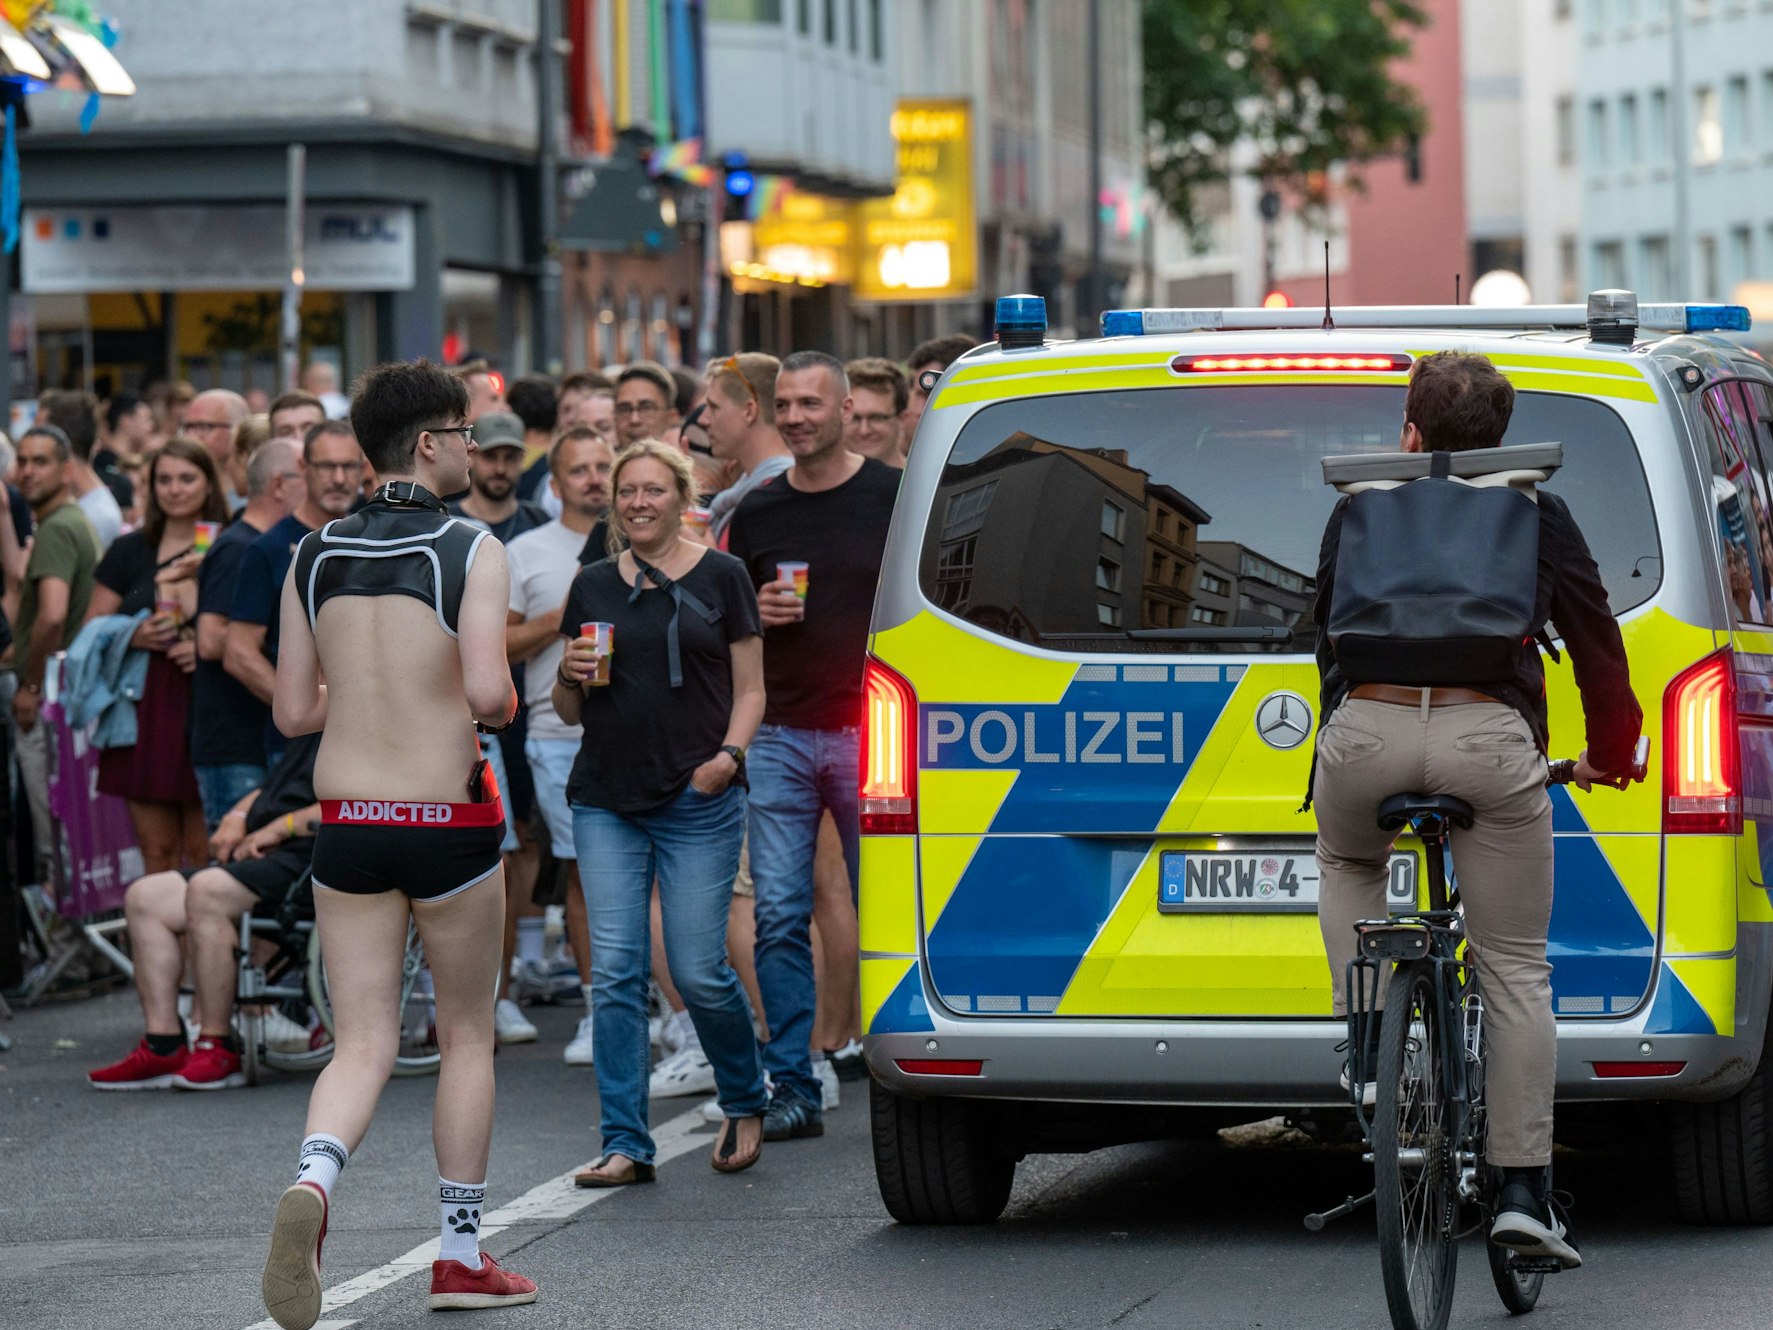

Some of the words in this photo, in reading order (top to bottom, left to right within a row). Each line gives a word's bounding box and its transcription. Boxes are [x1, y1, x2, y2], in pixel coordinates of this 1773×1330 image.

[927, 710, 1184, 764] POLIZEI
[338, 801, 453, 823] ADDICTED
[1168, 884, 1178, 895] D
[1185, 859, 1257, 898] NRW
[441, 1188, 483, 1198] GEAR
